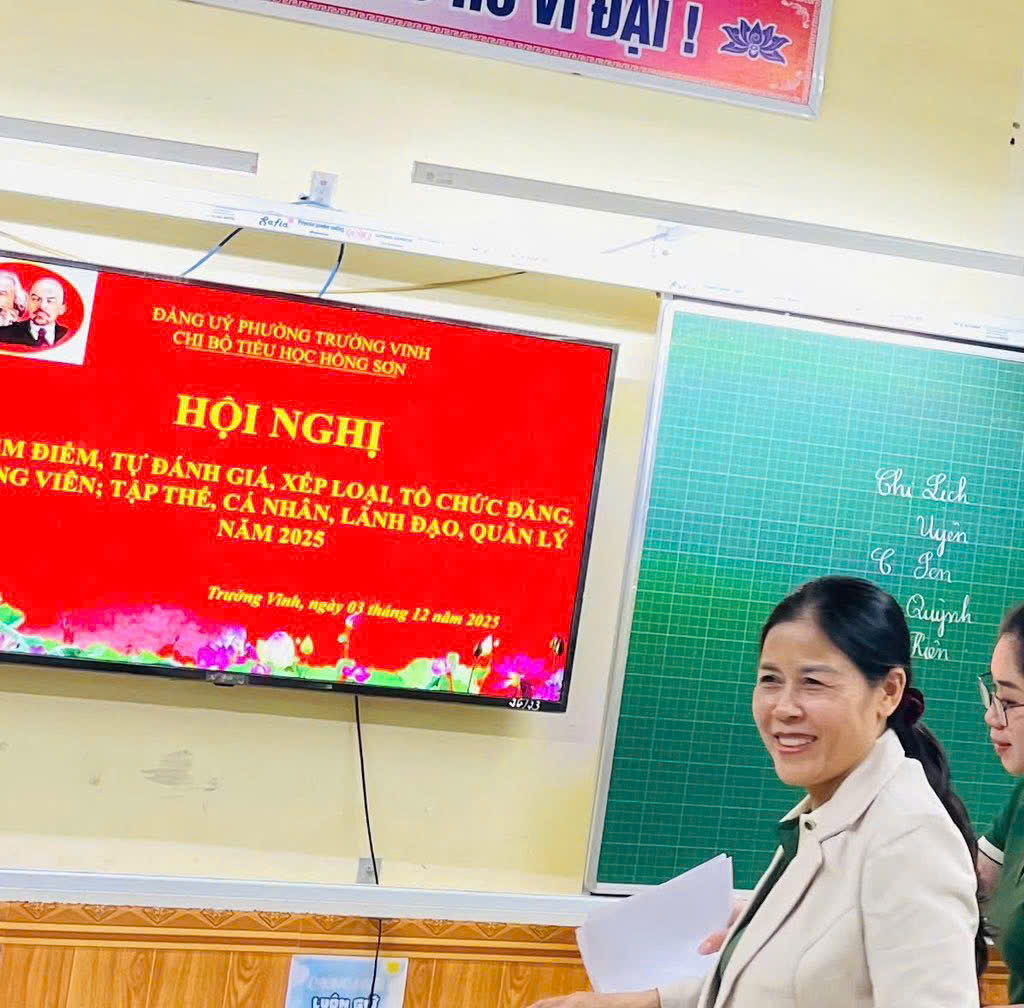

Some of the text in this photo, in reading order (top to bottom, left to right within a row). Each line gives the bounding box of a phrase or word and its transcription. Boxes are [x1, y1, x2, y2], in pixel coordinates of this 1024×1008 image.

[591, 0, 670, 54] ĐẠI
[683, 5, 701, 54] !
[153, 306, 205, 328] ĐẢNG
[238, 319, 311, 343] PHƯỜNG
[315, 331, 386, 354] TRƯỜNG
[390, 343, 432, 361] VINH
[172, 330, 205, 348] CHI
[208, 333, 233, 352] BỘ
[280, 345, 317, 365] HỌC
[320, 351, 369, 371] HỒNG
[373, 359, 406, 376] SƠN
[173, 394, 385, 459] HỘI NGHỊ
[31, 441, 104, 472] ĐIỂM,
[112, 451, 150, 477] TỰ
[151, 455, 222, 483] ĐÁNH
[226, 465, 275, 493] GIÁ,
[281, 471, 328, 496] XẾP
[331, 480, 394, 506] LOẠI,
[400, 486, 432, 508] TỔ
[436, 492, 503, 518] CHỨC
[507, 499, 575, 528] ĐẢNG,
[35, 469, 104, 500] VIÊN;
[111, 478, 160, 505] TẬP
[162, 485, 218, 512] THỂ,
[223, 491, 256, 514] CÁ
[262, 497, 335, 526] NHÂN,
[340, 504, 406, 532] LÃNH
[410, 515, 465, 541] ĐẠO,
[469, 521, 532, 546] QUẢN
[537, 529, 569, 550] LÝ
[217, 518, 326, 549] NĂM 2025
[308, 599, 344, 616] ngày
[346, 600, 366, 614] 03
[367, 603, 409, 623] tháng
[412, 607, 431, 622] 12
[431, 610, 463, 625] năm
[466, 612, 501, 630] 2025
[906, 593, 973, 638] Quỳnh
